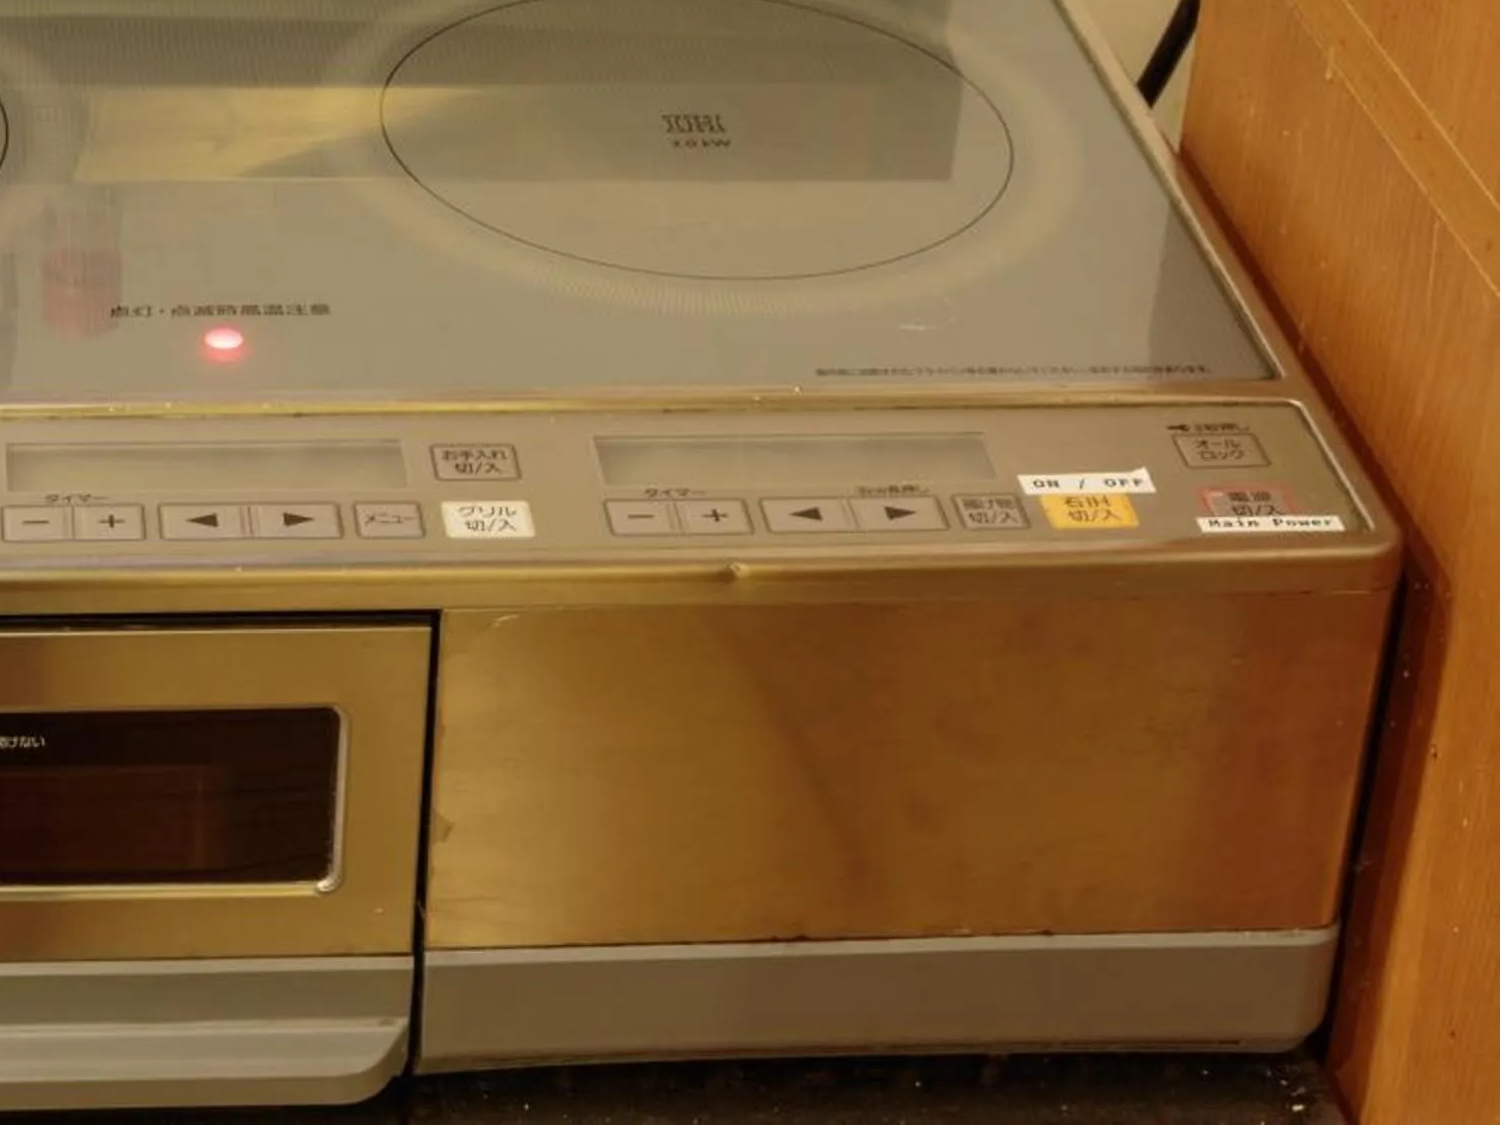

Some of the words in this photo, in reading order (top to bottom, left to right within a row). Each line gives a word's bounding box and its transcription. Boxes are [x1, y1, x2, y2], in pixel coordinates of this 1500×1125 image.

[1033, 478, 1060, 489] ON
[1104, 477, 1144, 488] OFF
[457, 505, 518, 518] グリル
[1208, 518, 1260, 528] Main
[1272, 518, 1333, 528] Power
